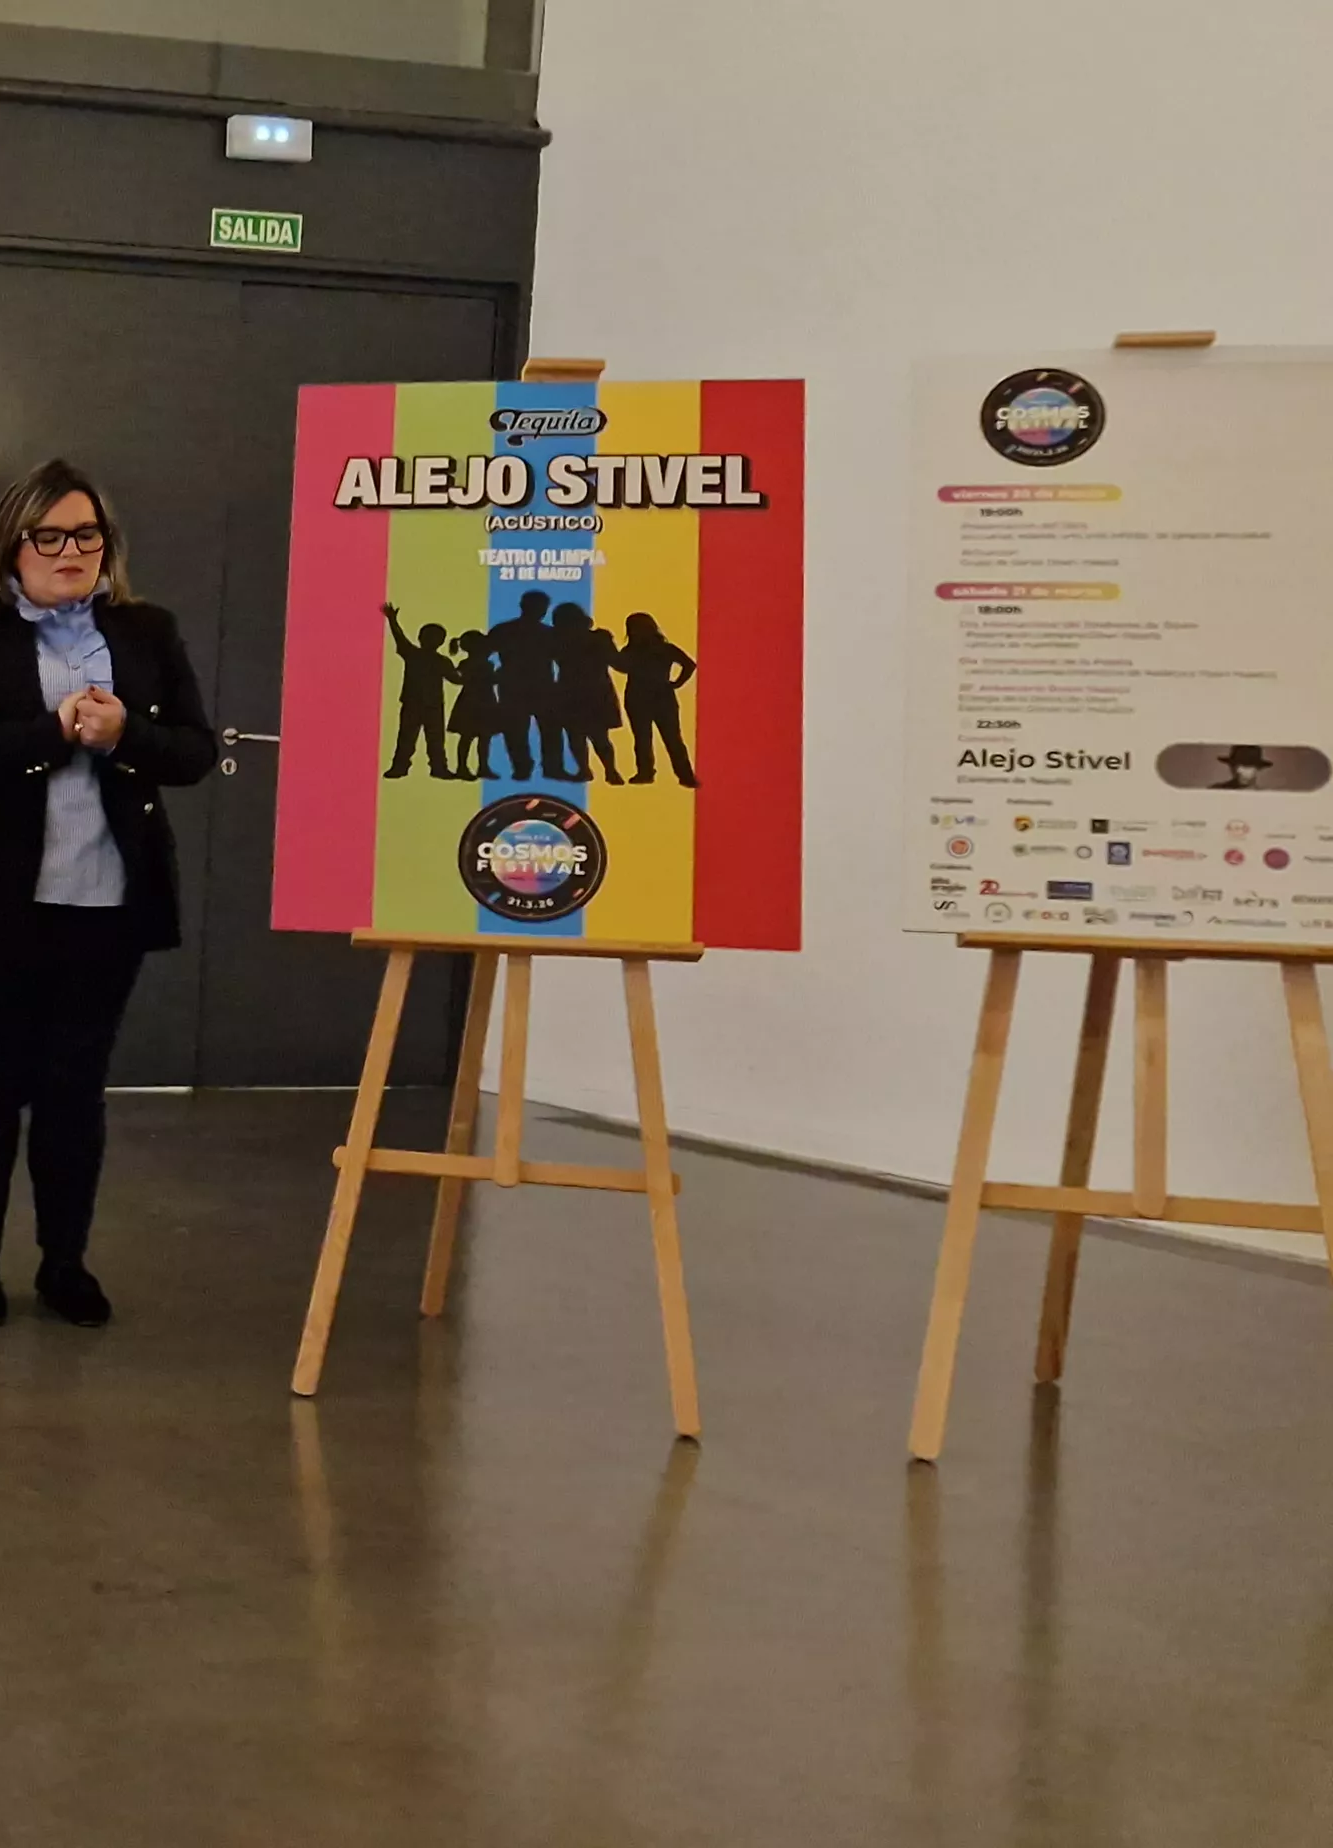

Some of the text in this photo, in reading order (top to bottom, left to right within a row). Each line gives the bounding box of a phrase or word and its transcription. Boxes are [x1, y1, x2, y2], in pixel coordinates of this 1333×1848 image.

[219, 216, 294, 245] SALIDA
[490, 407, 607, 446] Tequila
[333, 455, 770, 510] ALEJO STIVEL
[485, 512, 605, 534] (ACÚSTICO)
[478, 548, 608, 566] TEATRO OLIMPIA
[500, 567, 582, 580] 21 DE MARZO
[957, 748, 1131, 772] Alejo Stivel
[477, 841, 588, 864] COSMOS
[476, 859, 586, 876] FESTIVAL
